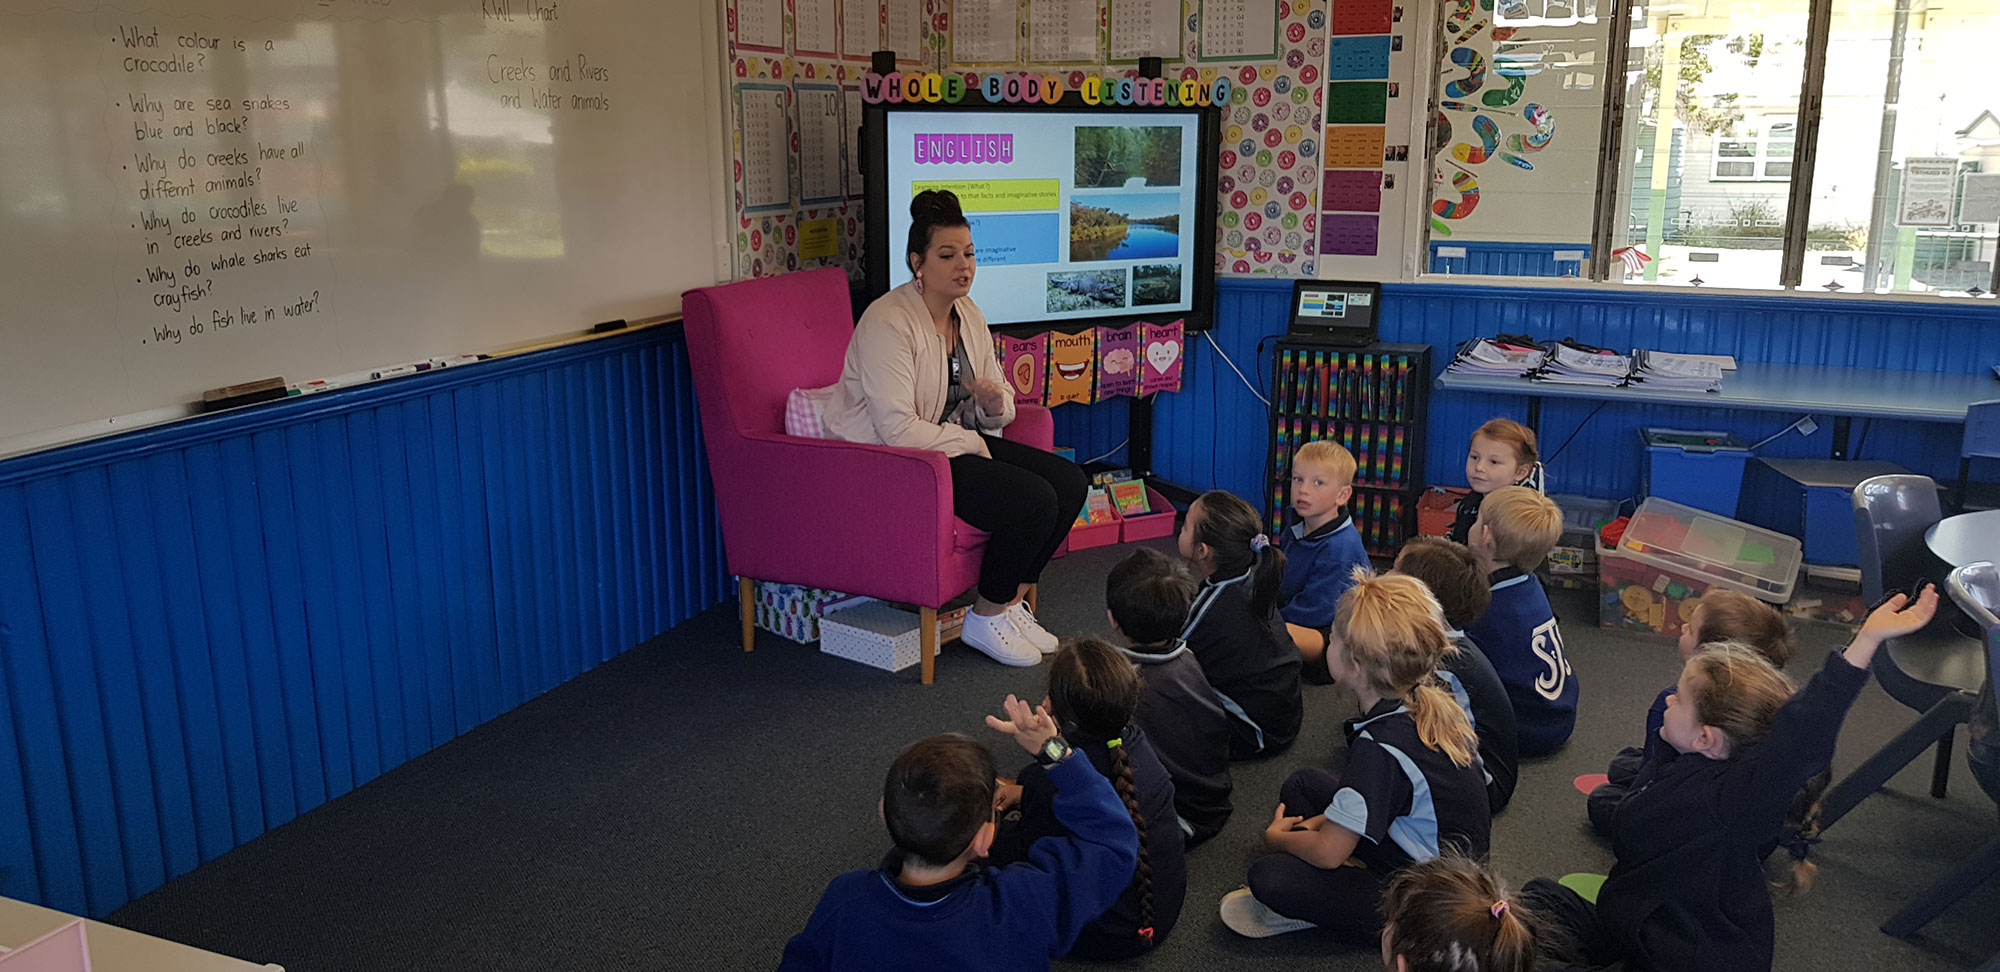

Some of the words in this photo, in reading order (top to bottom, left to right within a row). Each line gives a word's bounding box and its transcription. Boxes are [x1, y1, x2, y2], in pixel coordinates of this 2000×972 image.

[120, 25, 159, 50] What
[177, 32, 220, 50] colour
[233, 36, 246, 51] is
[265, 40, 274, 51] a
[124, 53, 205, 73] crocodile?
[486, 54, 536, 84] Creeks
[549, 60, 572, 82] and
[579, 54, 609, 82] Rivers
[500, 88, 521, 109] and
[531, 88, 562, 110] Water
[571, 91, 609, 111] animals
[865, 78, 957, 99] WHOLE
[988, 78, 1058, 98] BODY
[1088, 80, 1226, 101] LISTENING
[129, 93, 164, 121] Why
[174, 100, 195, 111] are
[207, 98, 232, 111] sea
[243, 94, 290, 110] snakes
[825, 93, 837, 117] 10
[135, 122, 163, 141] blue
[173, 122, 194, 137] and
[206, 116, 248, 135] black?
[135, 153, 167, 178] Why
[178, 148, 196, 170] do
[207, 148, 249, 166] creeks
[258, 142, 286, 160] have
[291, 141, 304, 157] all
[917, 139, 1011, 159] ENGLISH
[205, 167, 262, 193] animals?
[140, 211, 172, 235] Why
[181, 207, 196, 224] do
[209, 198, 267, 219] crocodiles
[277, 195, 298, 215] live
[146, 238, 159, 255] in
[174, 228, 213, 249] creeks
[221, 224, 242, 241] and
[250, 218, 289, 238] rivers?
[146, 267, 176, 288] Why
[184, 259, 200, 278] do
[211, 254, 246, 271] whale
[253, 247, 288, 265] sharks
[294, 243, 311, 258] eat
[153, 279, 213, 312] crayfish?
[153, 324, 182, 344] Why
[189, 315, 204, 335] do
[212, 310, 234, 331] fish
[240, 306, 257, 325] live
[264, 306, 275, 322] in
[283, 290, 320, 318] water?
[1055, 335, 1090, 349] mouth
[1106, 329, 1132, 343] brain
[1150, 325, 1178, 339] heart
[1012, 342, 1037, 353] ears
